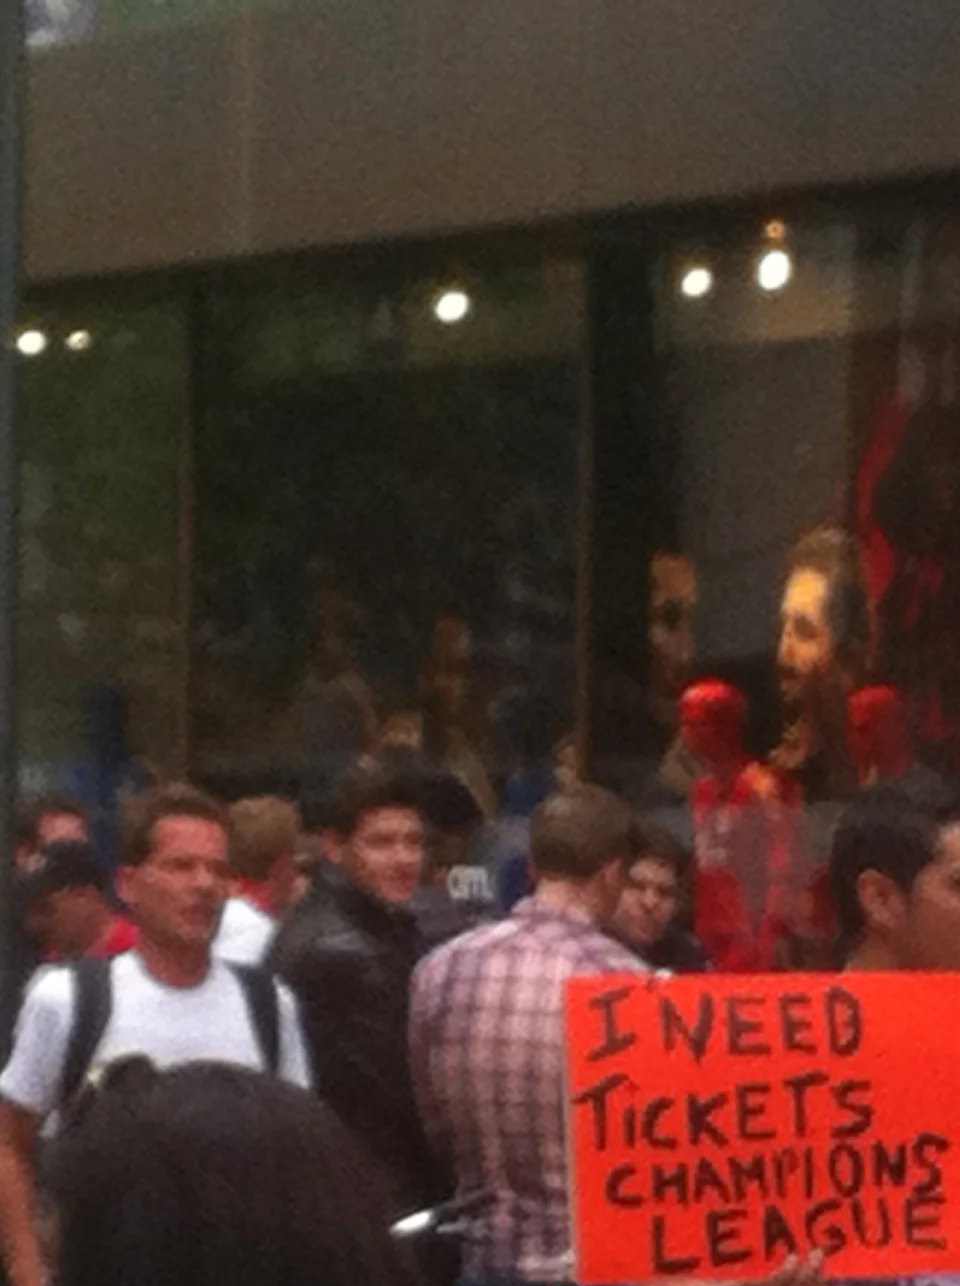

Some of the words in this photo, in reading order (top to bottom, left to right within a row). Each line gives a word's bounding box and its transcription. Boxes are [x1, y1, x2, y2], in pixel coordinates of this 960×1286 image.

[658, 984, 863, 1065] NEED
[605, 1131, 950, 1209] CHAMPIONS
[650, 1196, 948, 1274] LEAGUE
